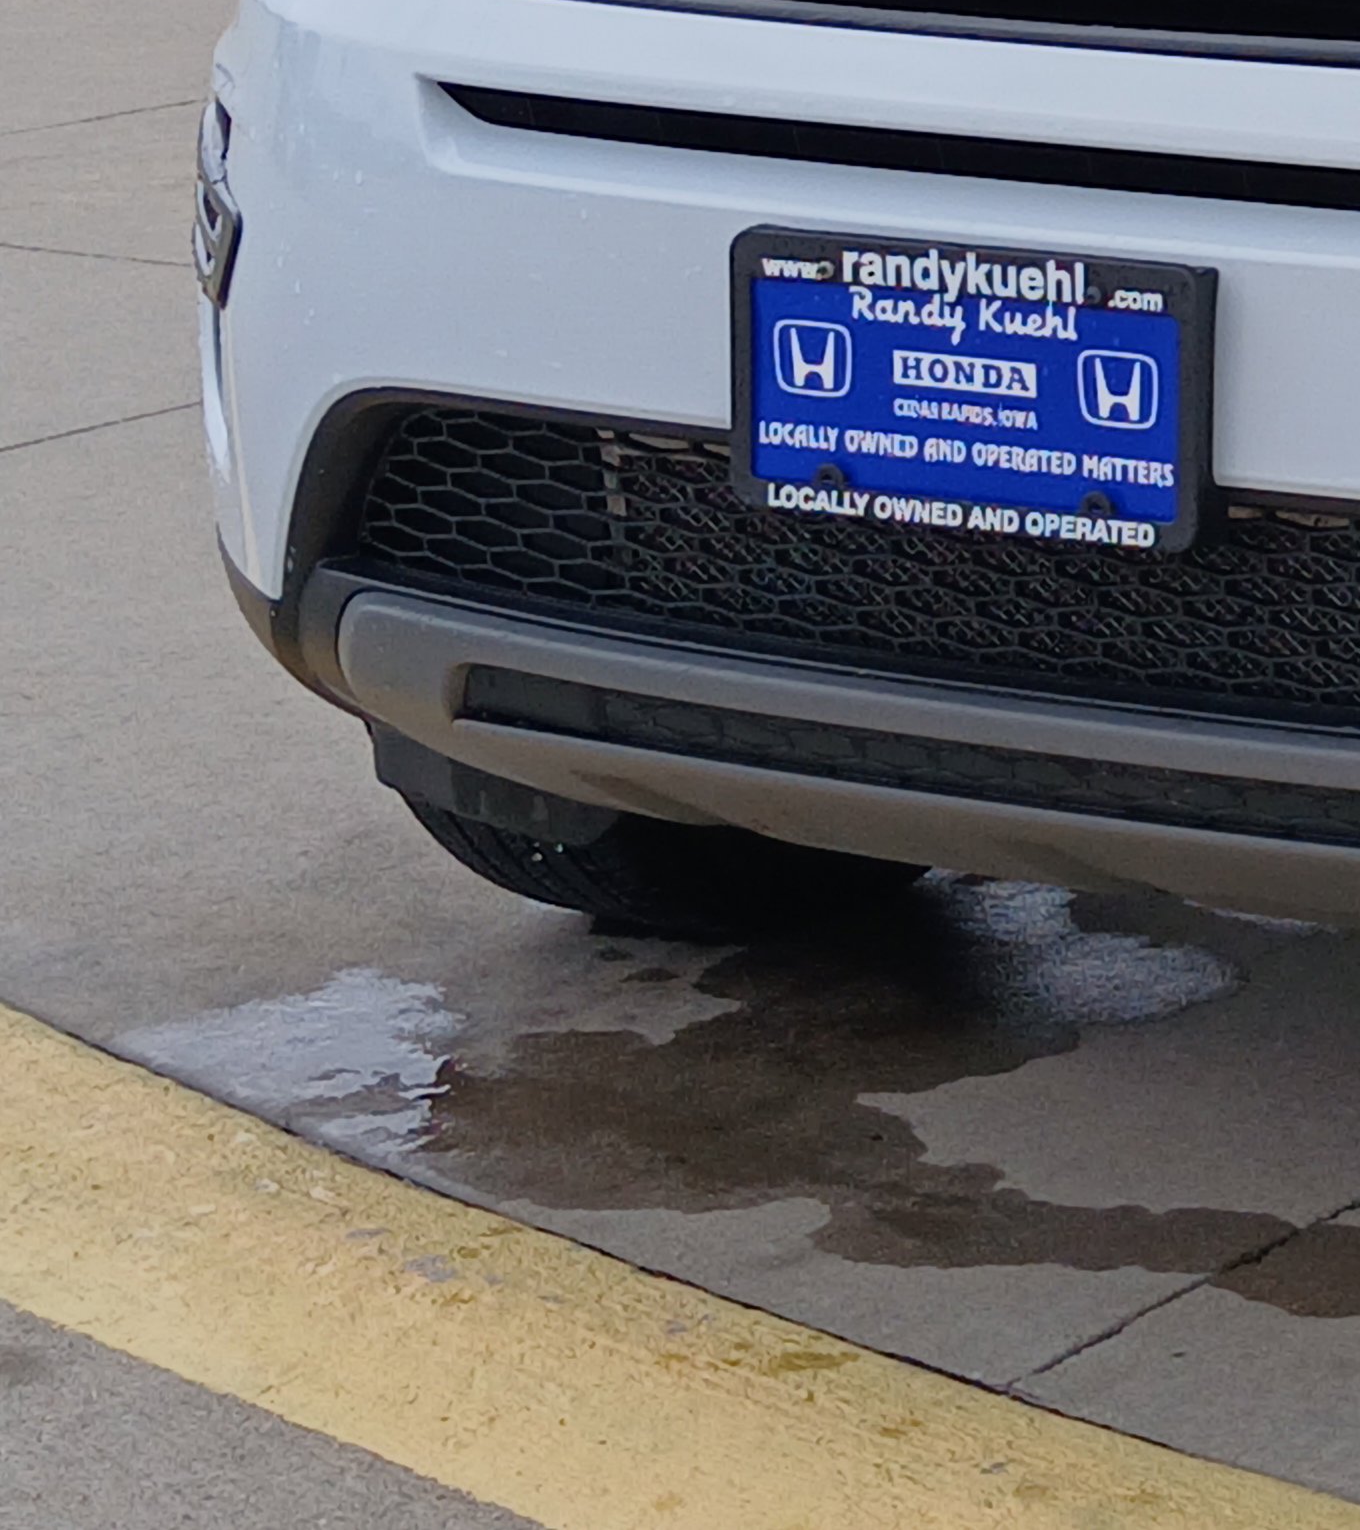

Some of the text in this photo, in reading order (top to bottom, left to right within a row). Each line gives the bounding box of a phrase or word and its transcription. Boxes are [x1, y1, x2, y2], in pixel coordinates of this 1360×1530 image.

[842, 248, 1085, 305] randykuehl
[849, 285, 1079, 346] Randy Kuehl
[899, 355, 1031, 393] HONDA
[758, 420, 1175, 489] LOCALLY OWNED AND OPERATED MATTERS
[767, 481, 1156, 549] LOCALLY OWNED AND OPERATED
